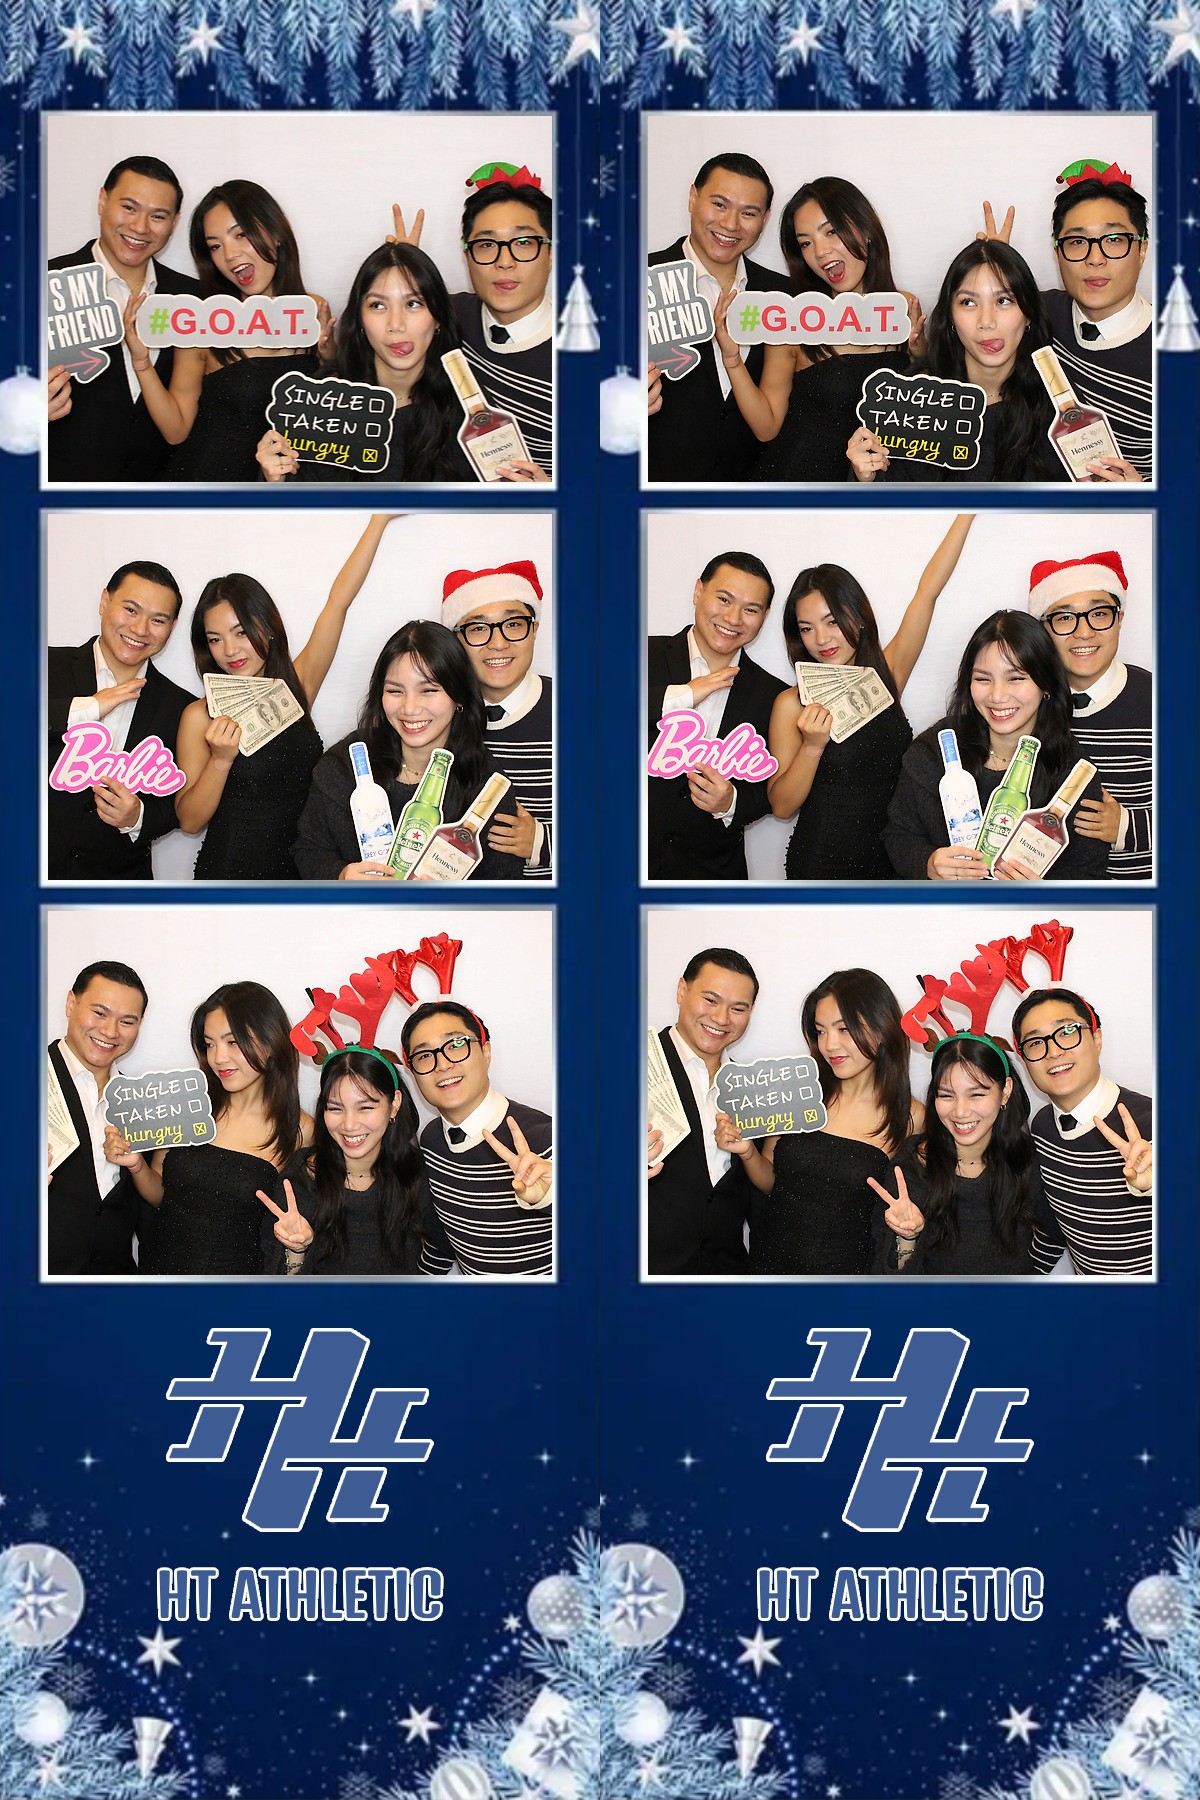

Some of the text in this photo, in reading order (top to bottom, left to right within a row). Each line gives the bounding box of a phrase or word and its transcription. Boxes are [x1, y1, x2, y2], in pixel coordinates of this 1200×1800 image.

[67, 270, 100, 308] MY
[657, 267, 690, 305] MY
[149, 308, 309, 336] #G.O.A.T.
[739, 305, 899, 333] #G.O.A.T.
[284, 384, 364, 411] SINGLE
[875, 381, 955, 409] SINGLE
[278, 413, 357, 435] TAKEN
[868, 410, 948, 432] TAKEN
[284, 429, 351, 464] hungry
[480, 442, 513, 459] Hennessy
[874, 426, 941, 461] hungry
[1070, 439, 1104, 456] Hennessy
[651, 714, 773, 777] Barbie
[56, 727, 181, 791] Barbie
[1019, 837, 1046, 859] Hennessy
[431, 852, 459, 874] Hennessy
[113, 1079, 182, 1105] SINGLE
[724, 1066, 792, 1093] SINGLE
[114, 1103, 182, 1125] TAKEN
[725, 1090, 793, 1112] TAKEN
[735, 1110, 795, 1132] hungry
[124, 1123, 184, 1146] hungry
